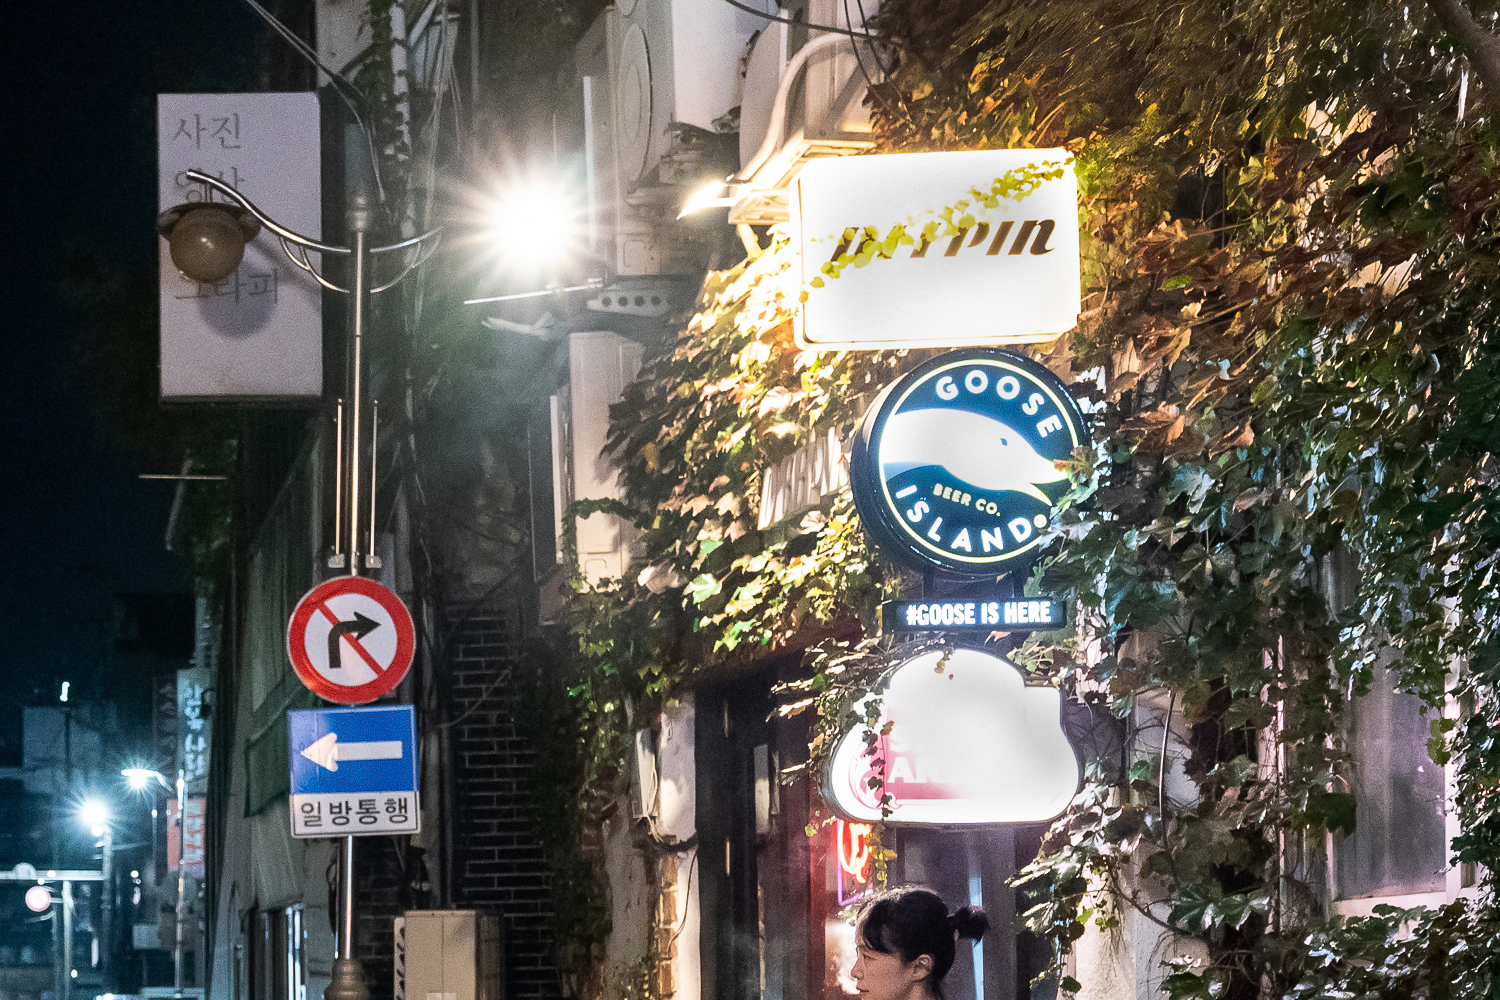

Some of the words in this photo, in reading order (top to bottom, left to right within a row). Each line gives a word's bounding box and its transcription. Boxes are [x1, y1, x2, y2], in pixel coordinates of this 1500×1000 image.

[173, 112, 241, 150] 사진
[935, 369, 1063, 438] GOOSE
[932, 482, 972, 507] BEER
[975, 498, 1001, 517] CO.
[905, 603, 976, 626] #GOOSE
[981, 602, 1000, 625] IS
[1004, 601, 1052, 624] HERE
[300, 797, 409, 828] 일방통행
